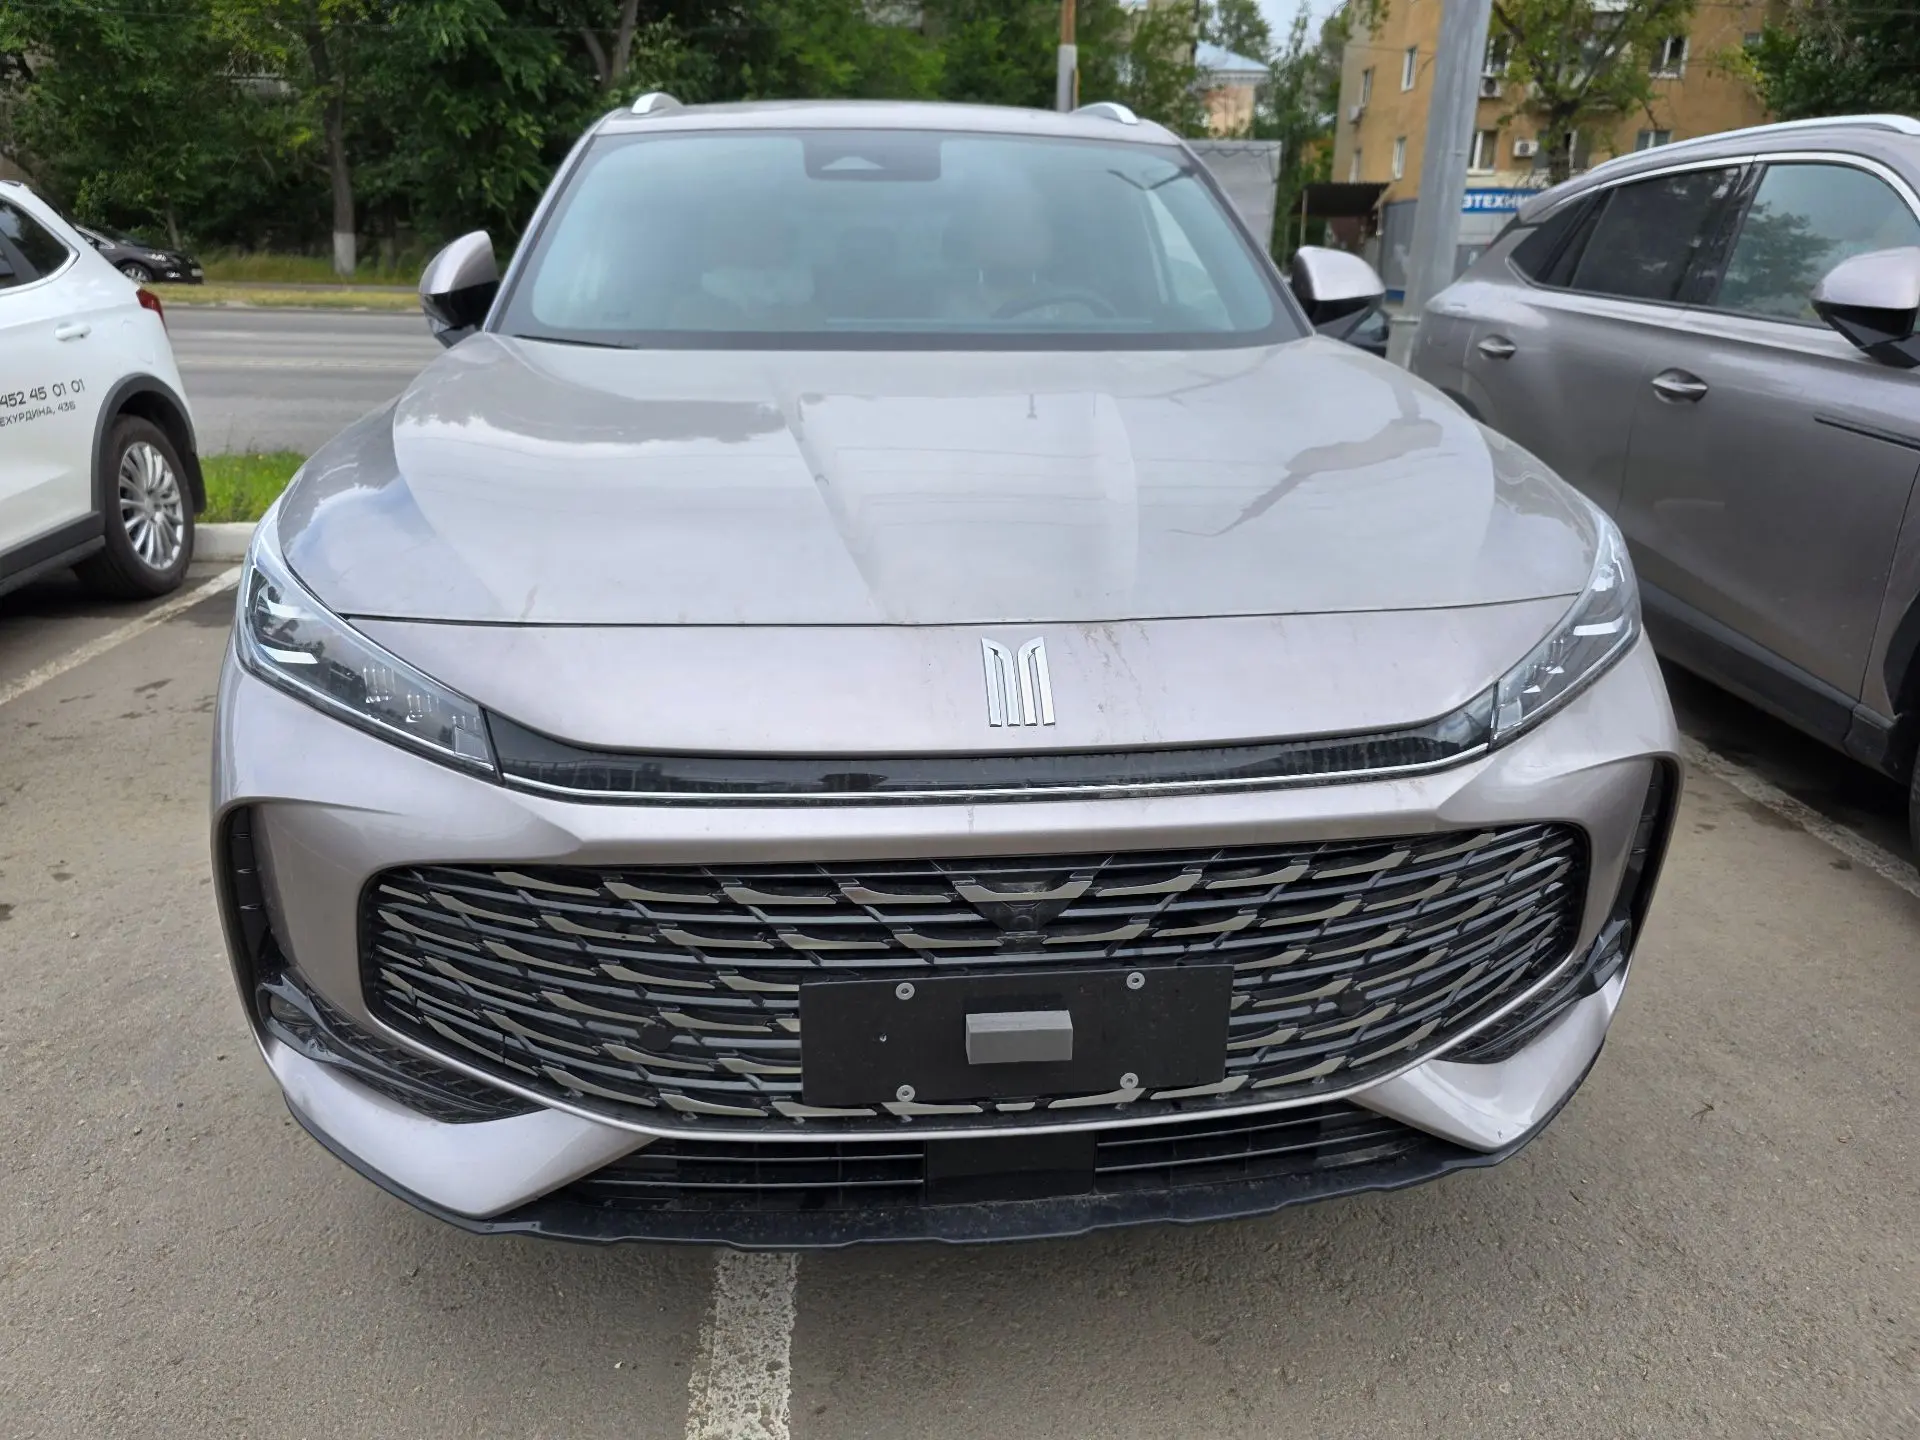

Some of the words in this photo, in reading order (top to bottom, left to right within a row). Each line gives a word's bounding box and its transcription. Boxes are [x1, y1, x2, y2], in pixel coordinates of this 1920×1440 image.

[29, 386, 47, 401] 45
[52, 382, 67, 397] 01
[71, 378, 85, 393] 01
